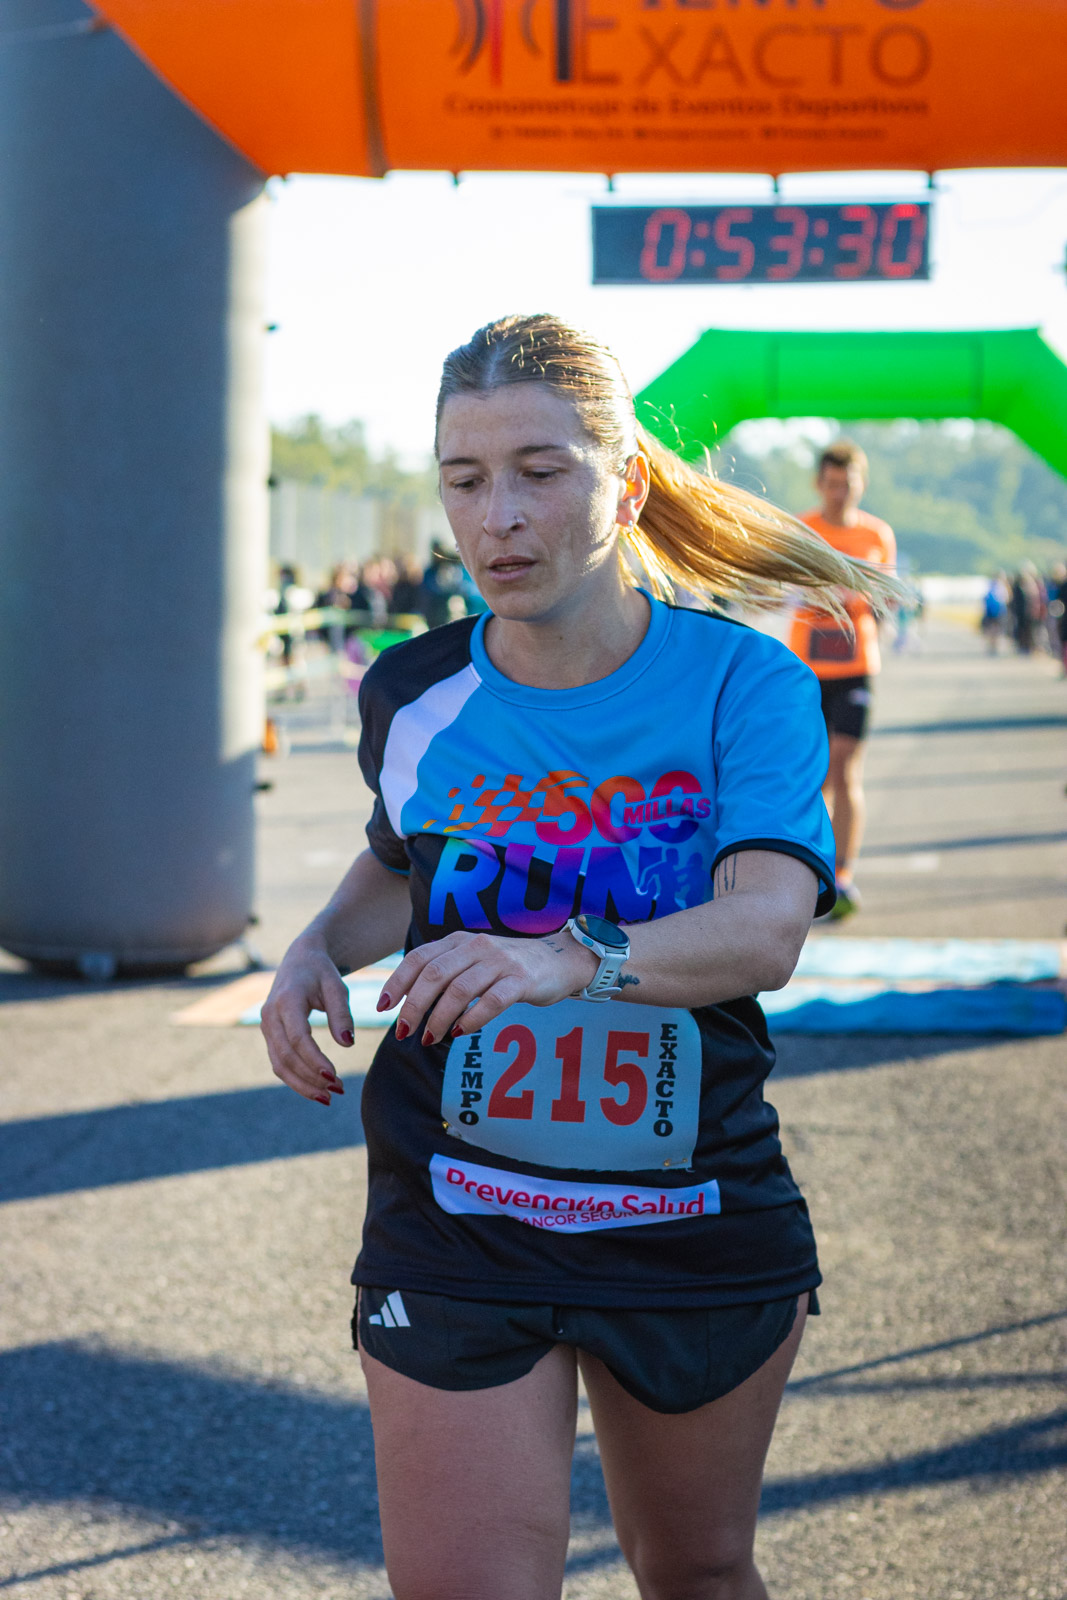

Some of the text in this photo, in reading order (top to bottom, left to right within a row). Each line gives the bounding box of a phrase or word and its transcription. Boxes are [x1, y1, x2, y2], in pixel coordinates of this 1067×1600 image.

[578, 0, 933, 87] EXACTO
[622, 797, 712, 825] MILLAS
[428, 836, 665, 935] RUN
[458, 1028, 483, 1126] IEMPO
[487, 1023, 650, 1127] 215
[653, 1022, 678, 1138] EXACTO
[512, 1213, 578, 1228] ANCOR
[621, 1191, 705, 1215] Salud
